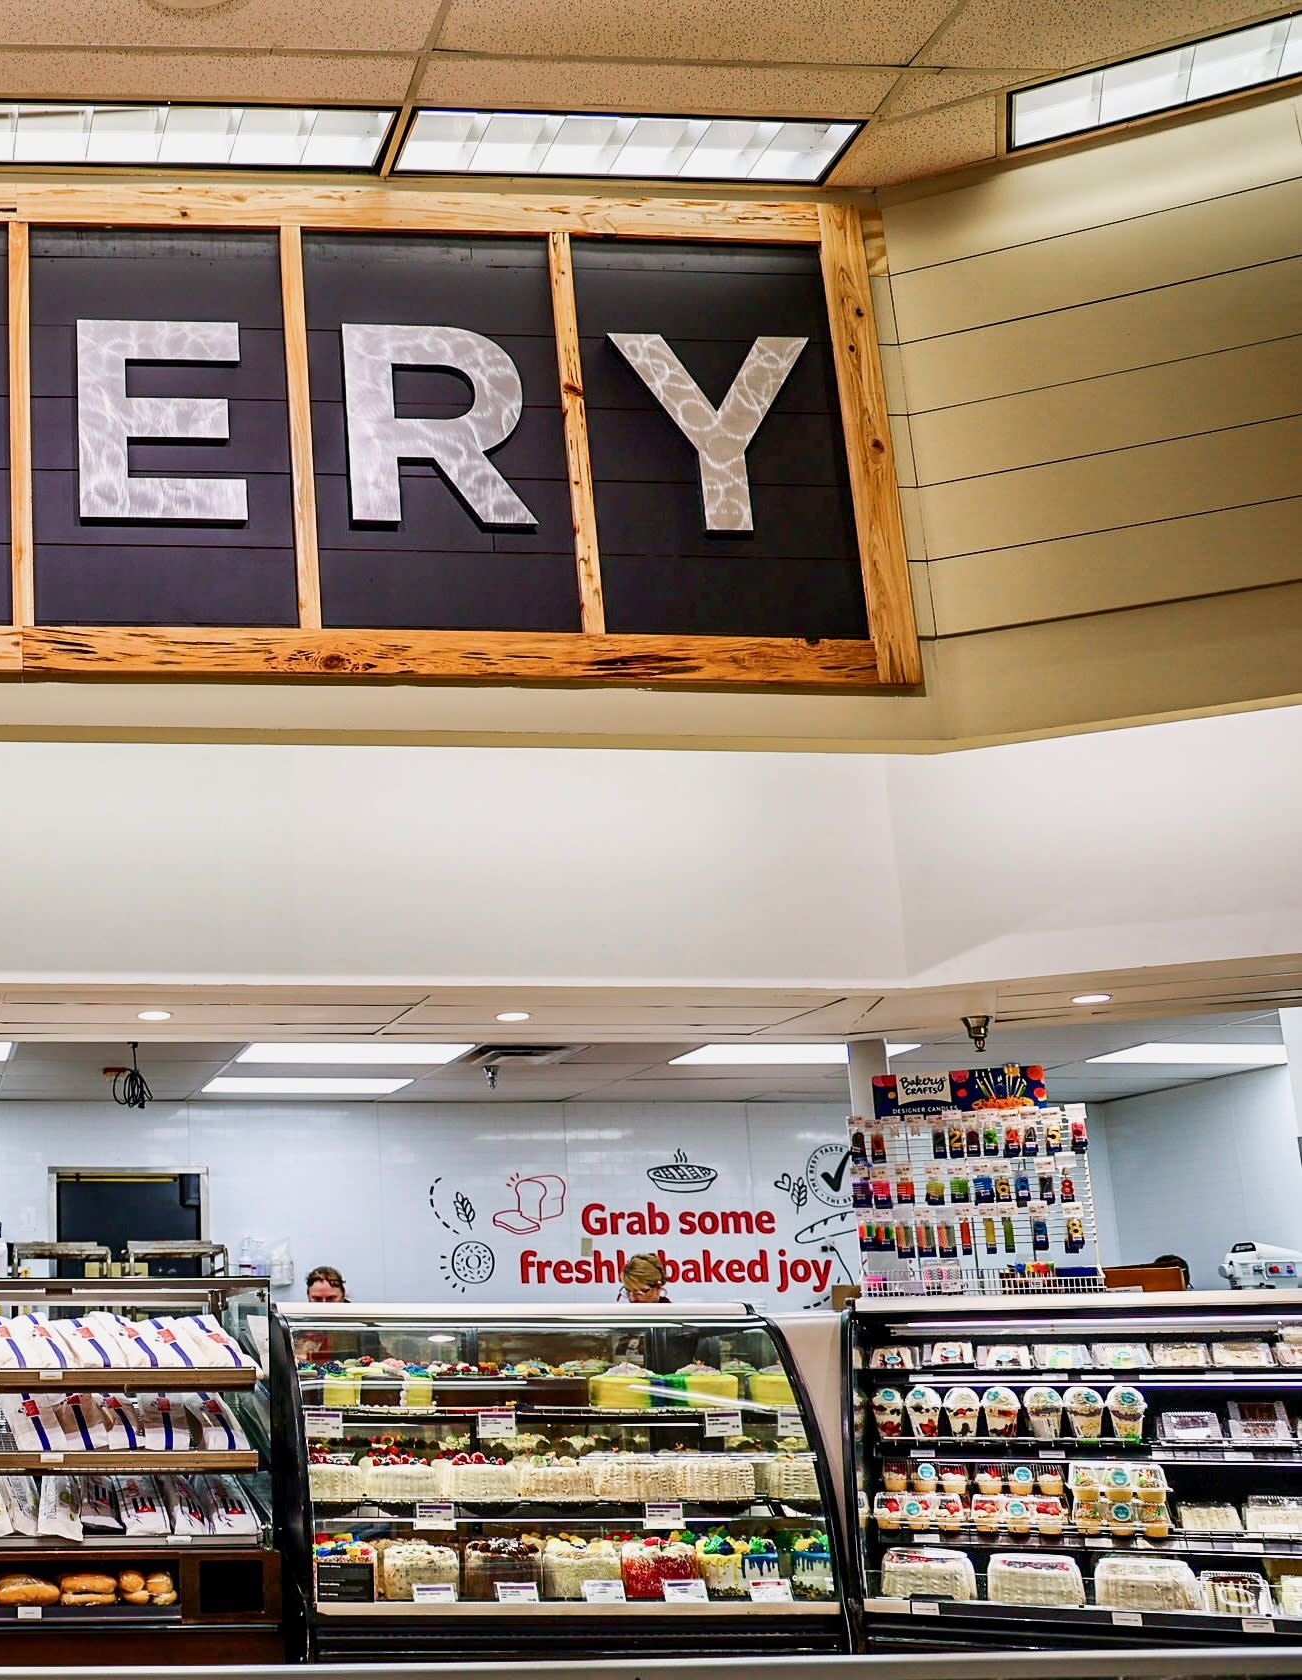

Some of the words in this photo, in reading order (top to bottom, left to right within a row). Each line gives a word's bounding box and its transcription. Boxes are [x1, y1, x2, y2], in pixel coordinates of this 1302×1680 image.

[899, 1076, 945, 1092] Bakery
[905, 1086, 938, 1095] CRAFTS
[892, 1106, 927, 1114] DESIGNER
[819, 1146, 844, 1155] TASTE
[581, 1202, 670, 1236] Grab
[679, 1210, 776, 1235] some
[520, 1250, 627, 1284] freshl
[657, 1249, 770, 1284] baked
[777, 1249, 832, 1293] joy
